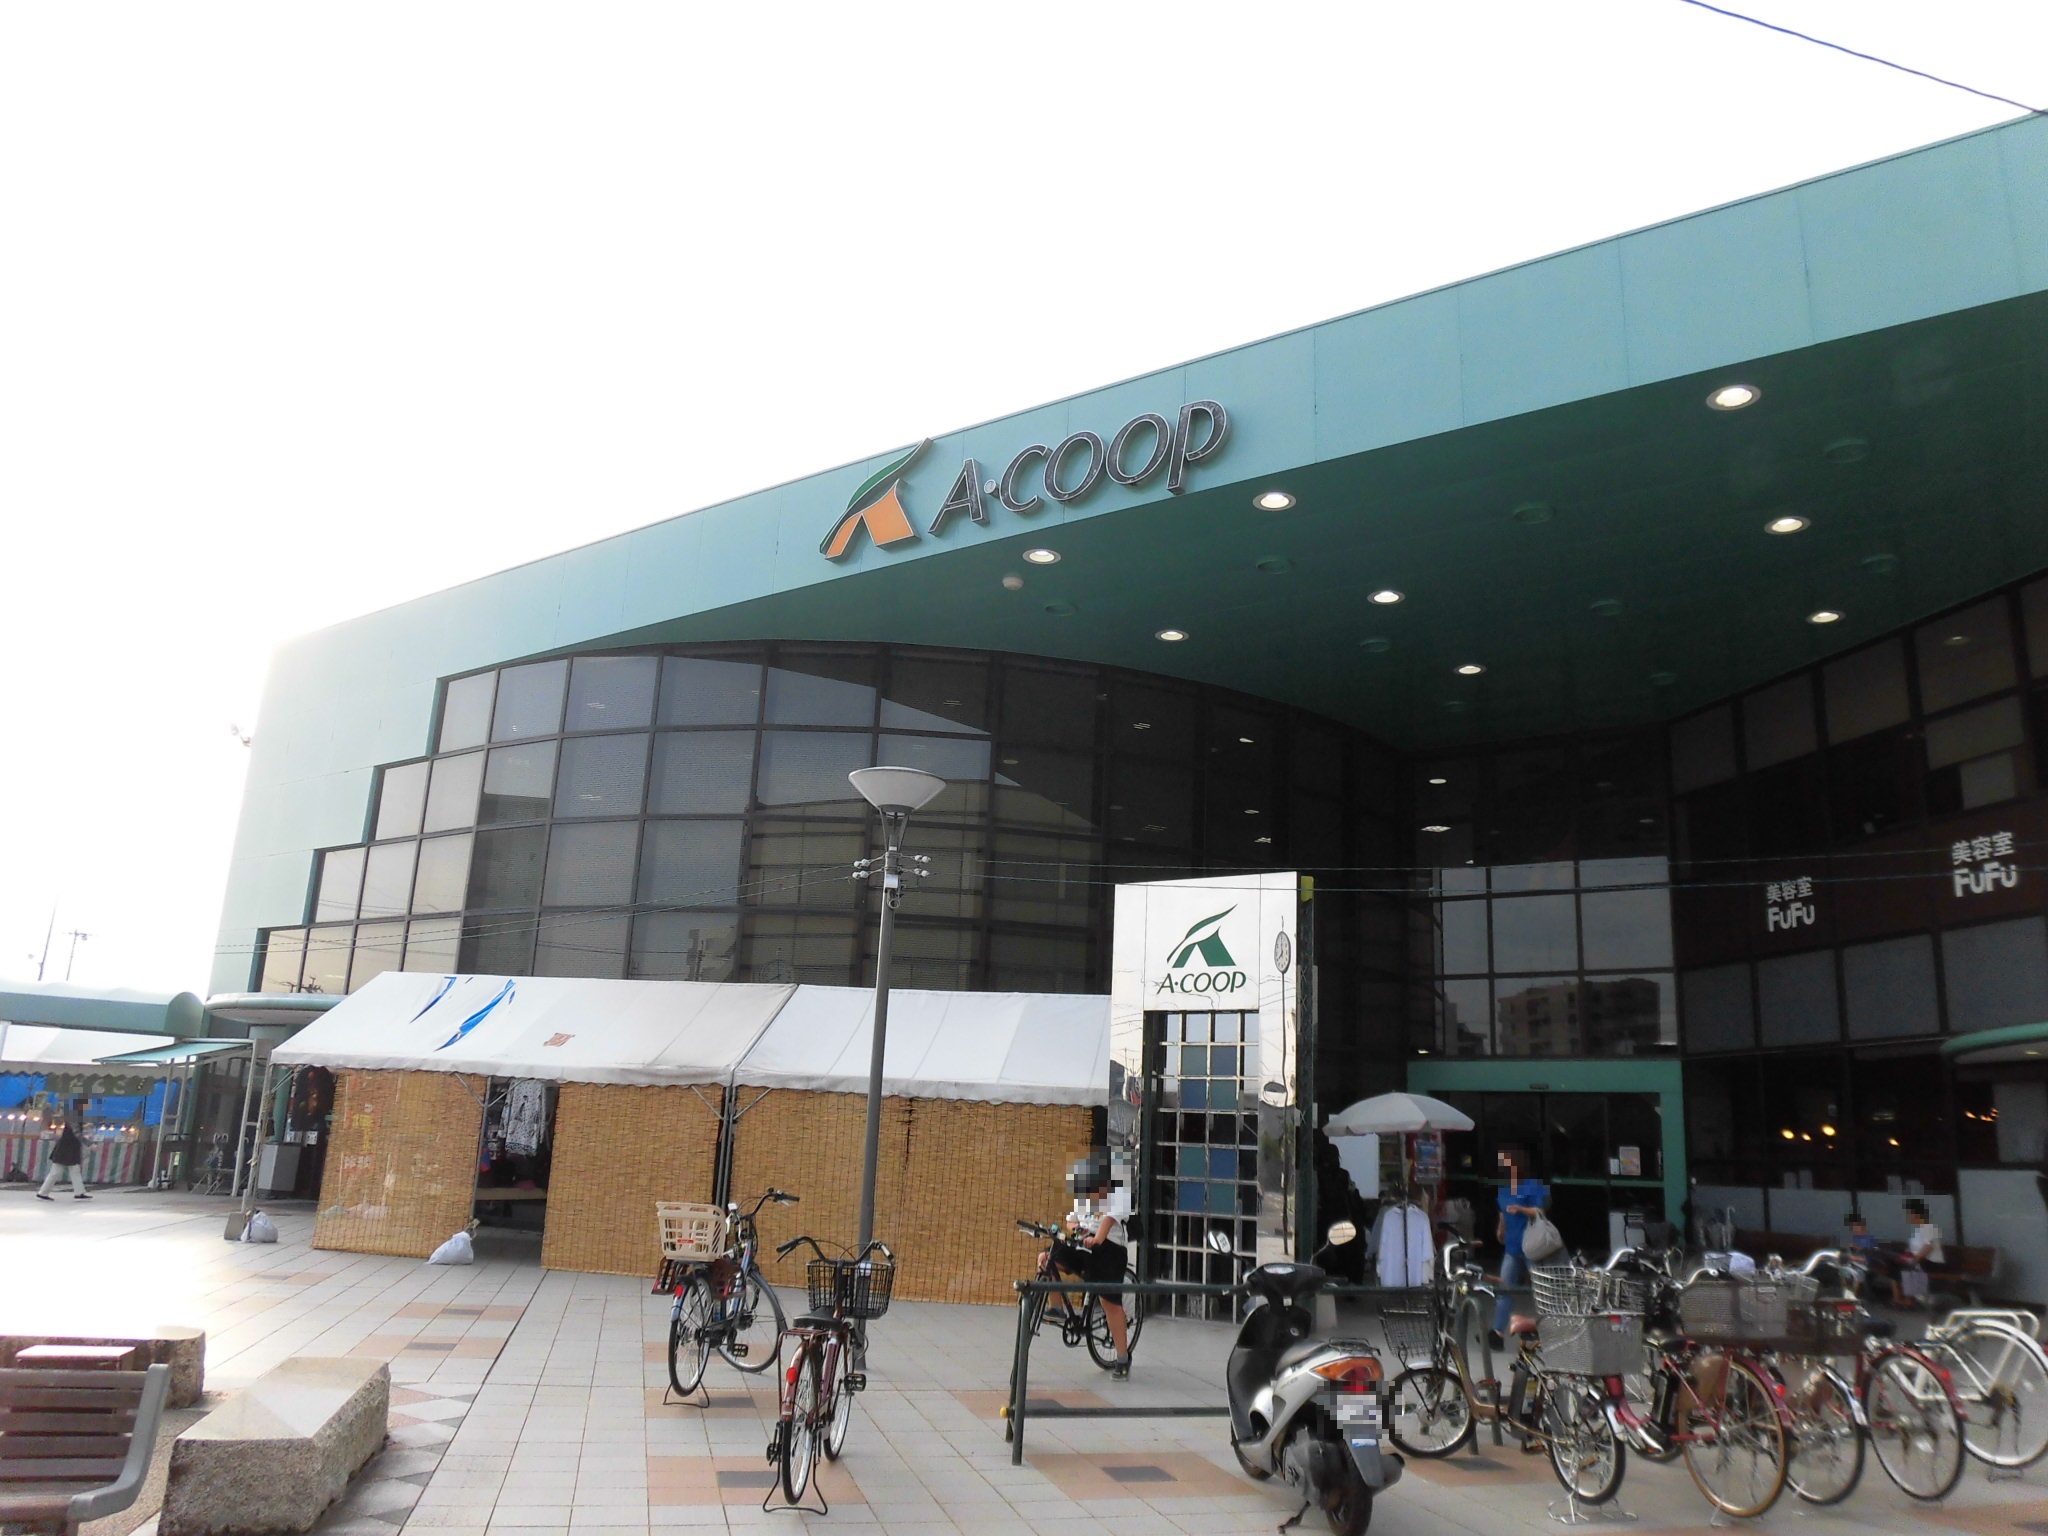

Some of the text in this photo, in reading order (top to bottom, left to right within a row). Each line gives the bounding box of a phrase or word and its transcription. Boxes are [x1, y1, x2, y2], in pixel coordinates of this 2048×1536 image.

[1952, 831, 2015, 865] 美容室
[1766, 876, 1813, 904] 美容室
